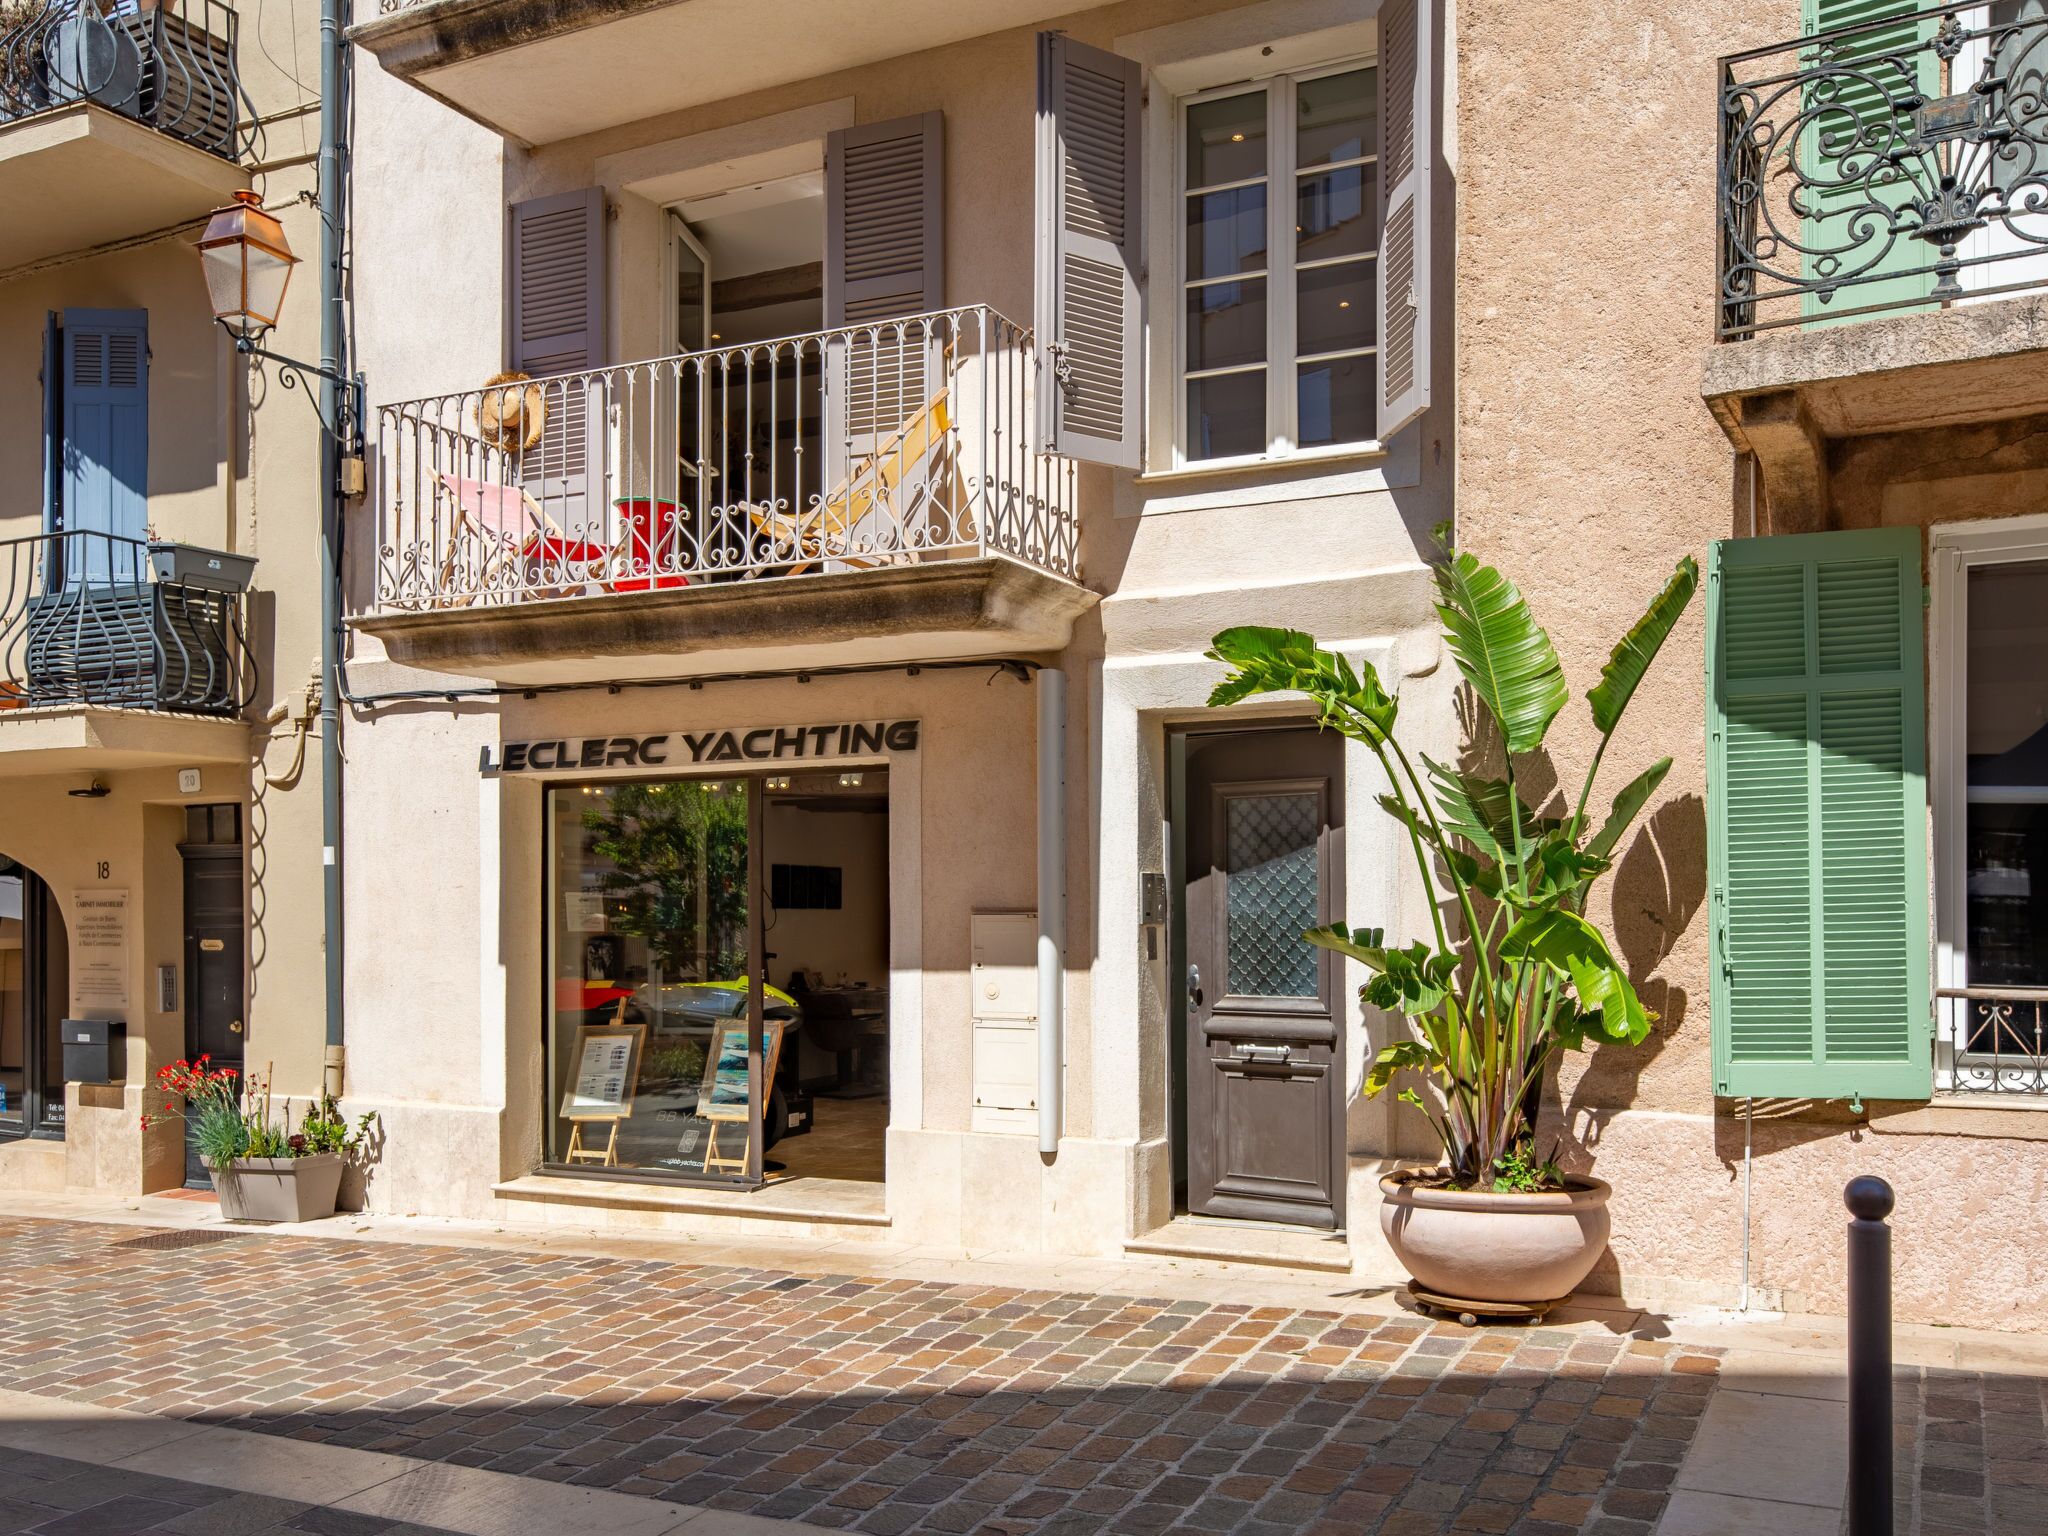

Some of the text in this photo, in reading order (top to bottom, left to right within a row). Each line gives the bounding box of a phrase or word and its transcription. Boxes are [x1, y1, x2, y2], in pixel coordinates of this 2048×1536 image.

[479, 720, 919, 772] LECLERC YACHTING
[96, 861, 110, 879] 18
[76, 900, 124, 908] CABINET IMMOBILIER
